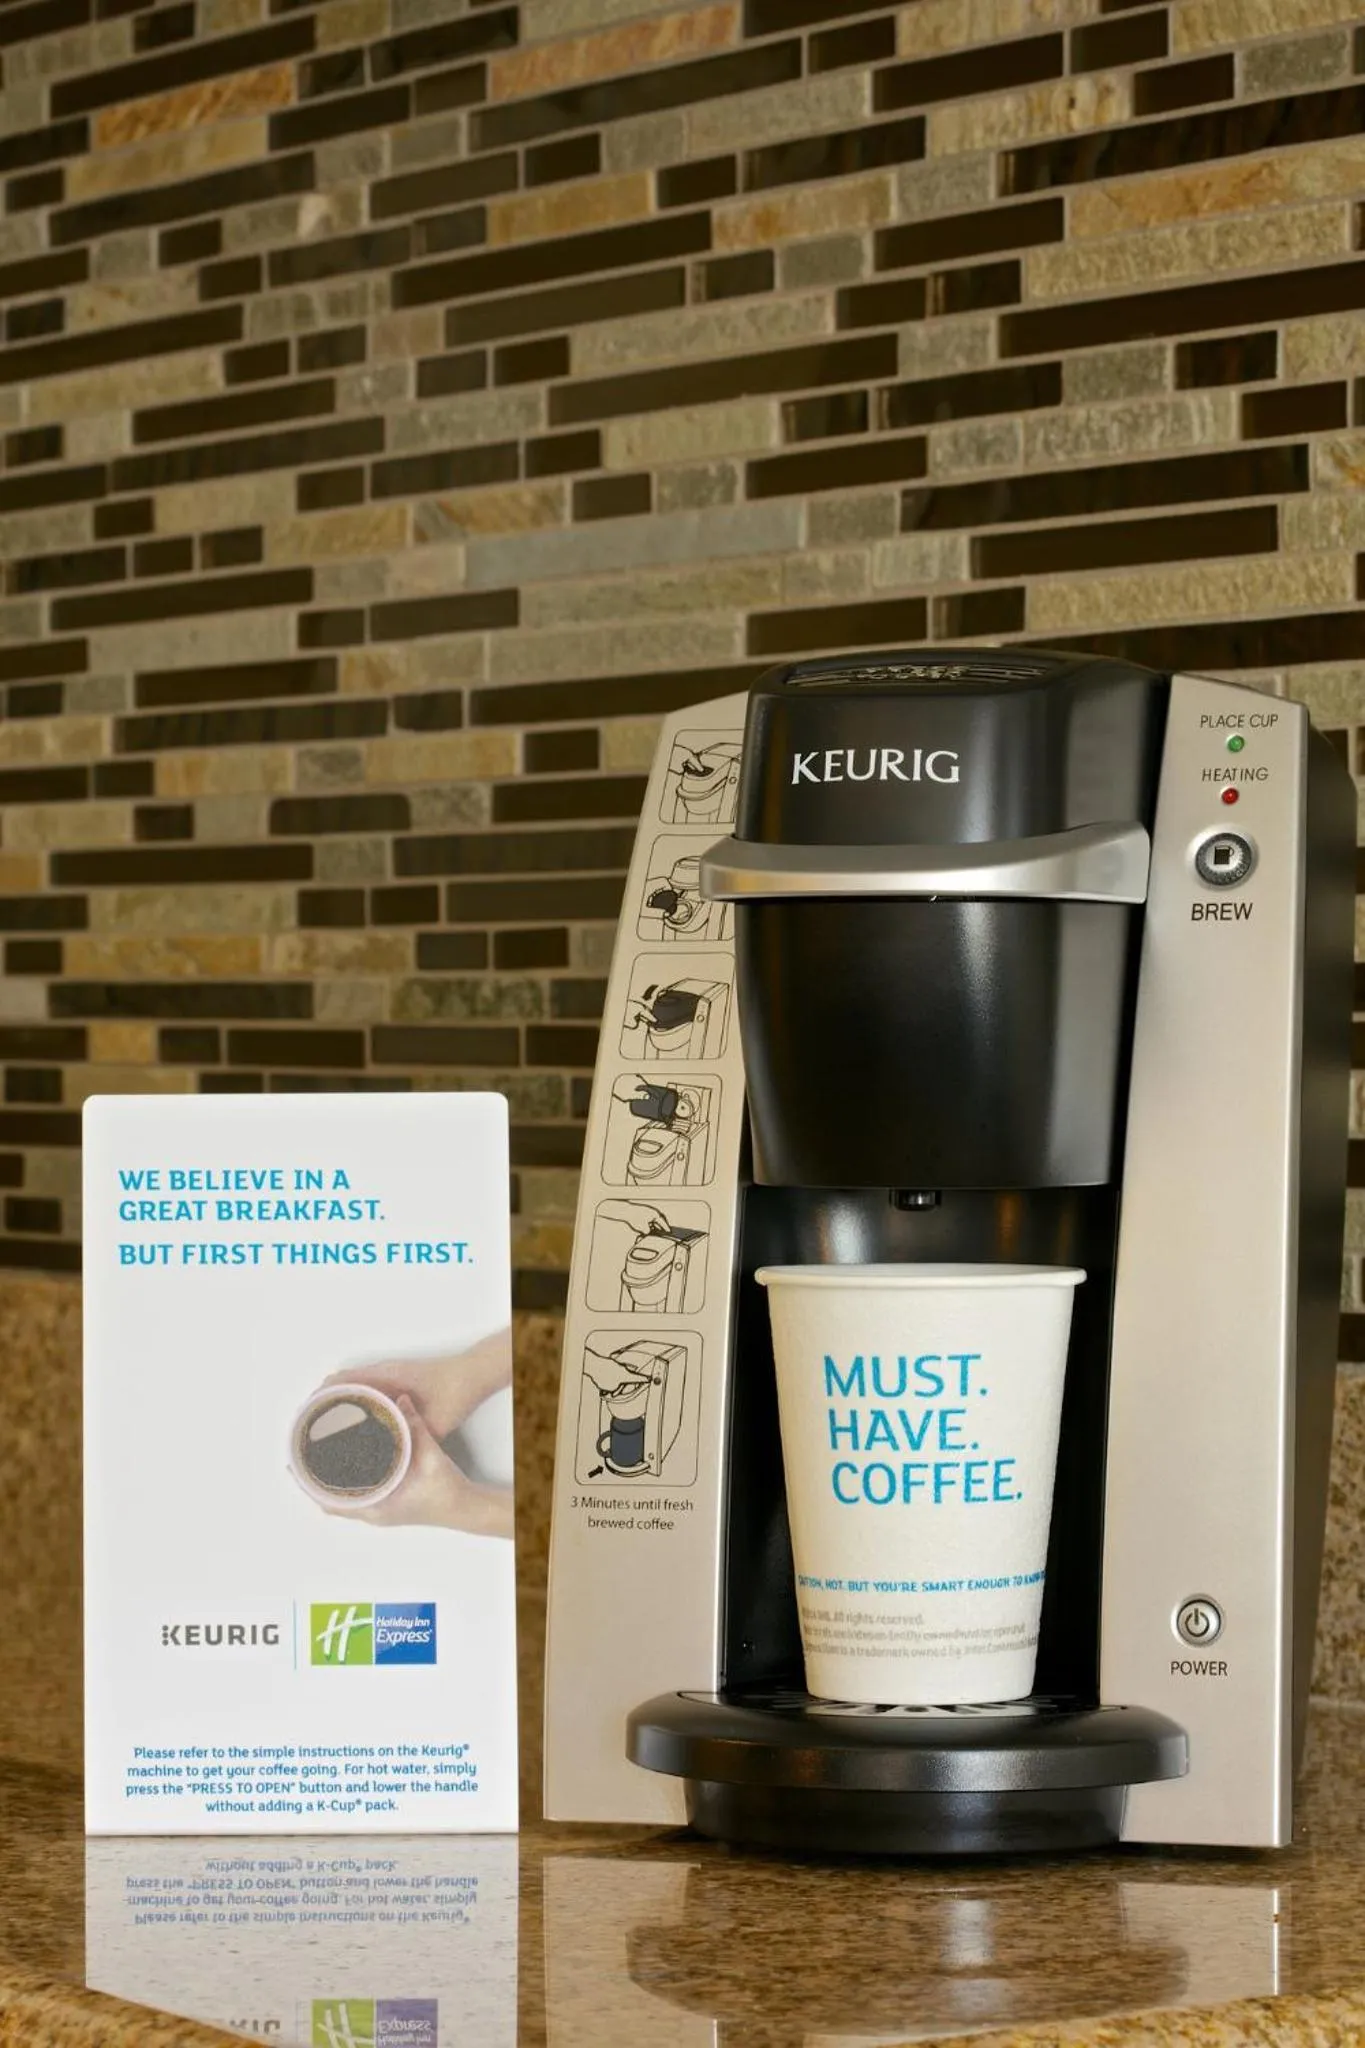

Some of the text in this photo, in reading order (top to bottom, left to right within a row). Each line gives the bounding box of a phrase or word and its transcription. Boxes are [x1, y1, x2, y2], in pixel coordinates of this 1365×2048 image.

[1200, 713, 1279, 728] PLACE CUP
[791, 749, 960, 785] KEURIG
[1201, 767, 1269, 782] HEATING
[1191, 902, 1253, 921] BREW
[119, 1169, 350, 1190] WE BELIEVE IN A
[119, 1199, 385, 1221] GREAT BREAKFAST.
[119, 1242, 474, 1265] BUT FIRST THINGS FIRST.
[824, 1354, 987, 1397] MUST.
[829, 1408, 979, 1451] HAVE.
[832, 1458, 1022, 1505] COFFEE.
[570, 1496, 693, 1511] 3 Minutes until fresh
[587, 1516, 674, 1530] brewed coffee
[848, 1579, 869, 1592] BUT
[873, 1581, 917, 1592] YOU'RE
[922, 1580, 964, 1592] SMART
[968, 1577, 1010, 1590] ENOUGH
[376, 1616, 431, 1629] Holiday Inn
[162, 1625, 279, 1646] KEURIG
[1170, 1660, 1228, 1676] POWER
[134, 1747, 175, 1758] Please
[179, 1747, 208, 1758] refer
[212, 1748, 225, 1758] to
[229, 1747, 249, 1757] the
[252, 1746, 295, 1760] simple
[299, 1746, 375, 1757] instructions
[378, 1748, 393, 1756] on
[398, 1745, 418, 1756] the
[127, 1762, 477, 1778] machine to get your coffee going. For hot water, simply
[126, 1784, 159, 1797] press
[163, 1783, 183, 1794] the
[236, 1783, 252, 1794] TO
[300, 1781, 341, 1793] button
[345, 1781, 369, 1792] and
[373, 1781, 406, 1792] lower
[411, 1781, 431, 1791] the
[435, 1780, 478, 1791] handle
[206, 1800, 254, 1812] without
[258, 1800, 302, 1813] adding
[306, 1802, 313, 1811] a
[365, 1799, 399, 1812] pack.
